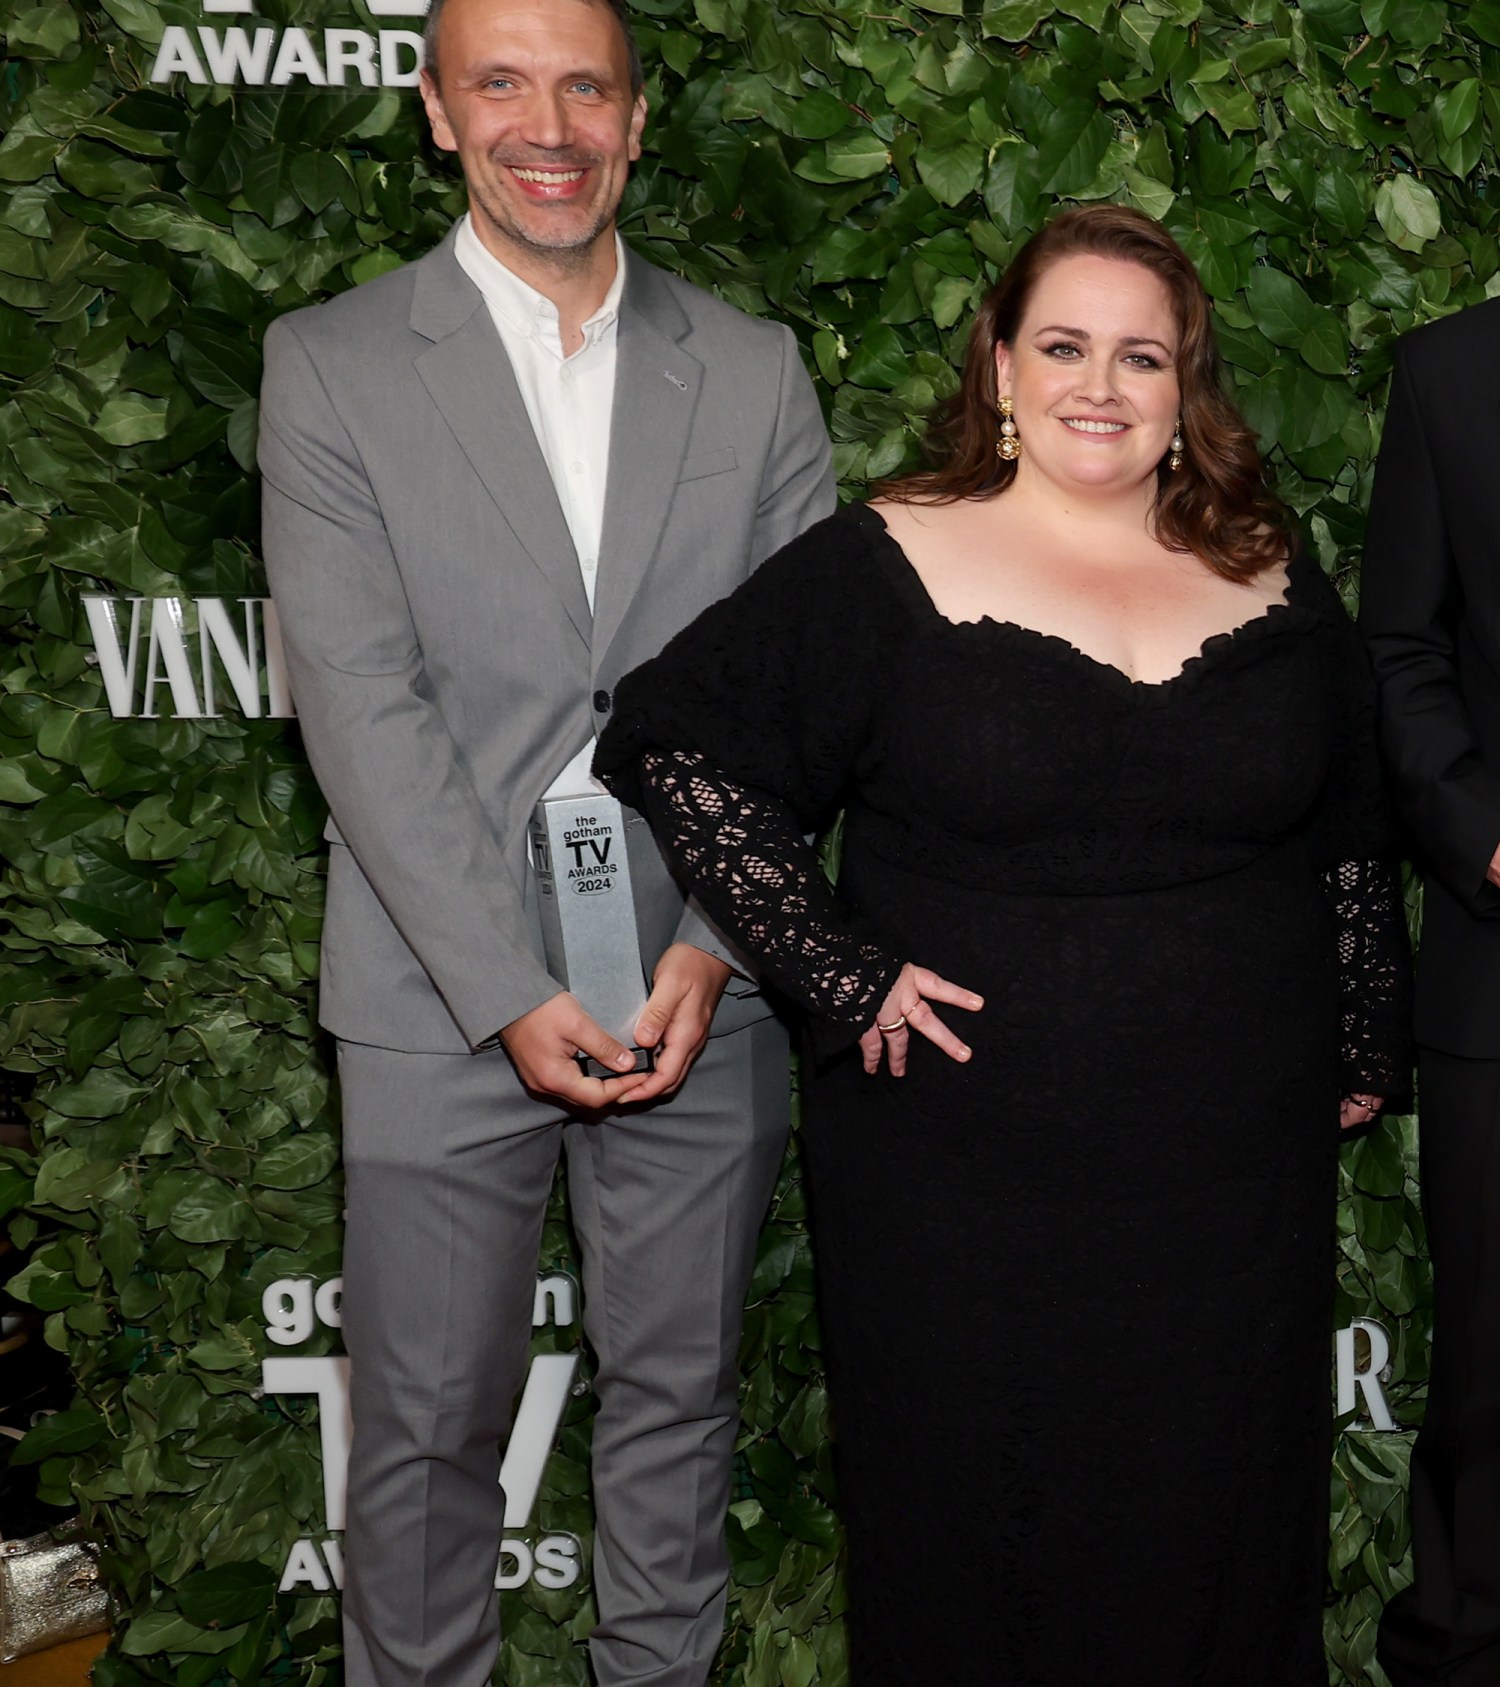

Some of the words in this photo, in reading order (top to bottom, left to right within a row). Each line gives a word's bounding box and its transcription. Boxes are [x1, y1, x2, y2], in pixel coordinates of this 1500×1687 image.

[151, 26, 426, 88] AWARD
[80, 594, 297, 718] VANI
[575, 816, 597, 828] the
[563, 825, 612, 843] gotham
[565, 837, 611, 868] TV
[567, 863, 618, 879] AWARDS
[577, 877, 611, 893] 2024
